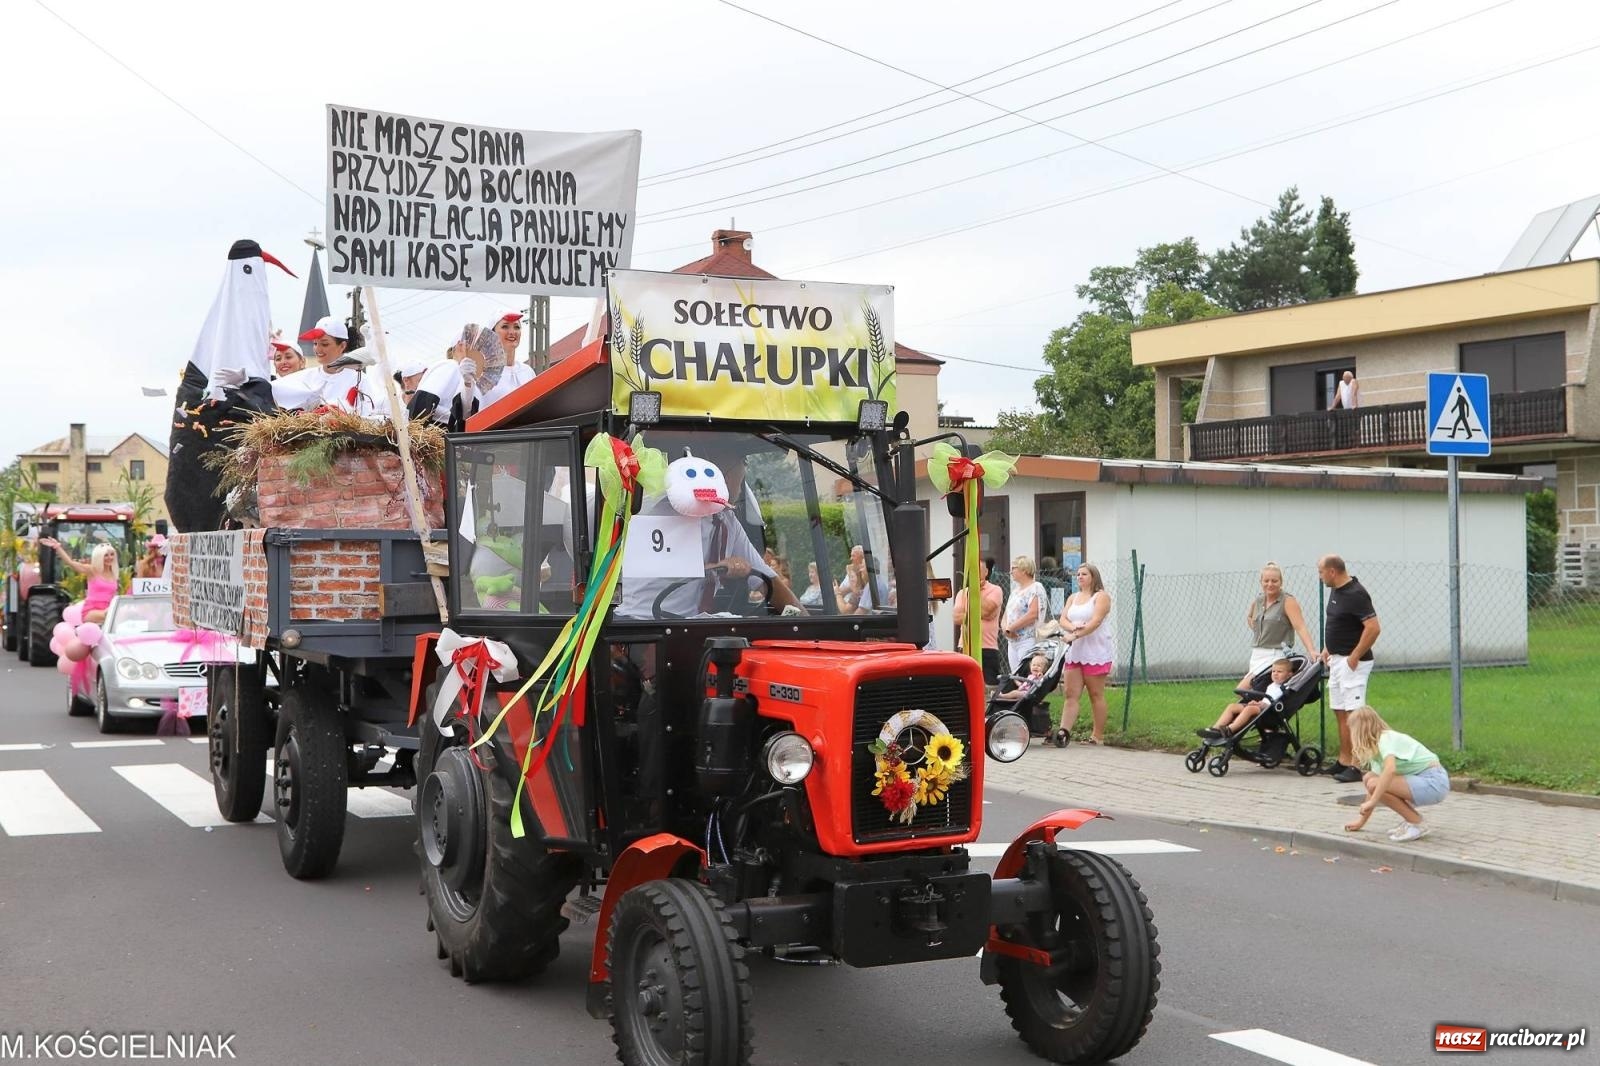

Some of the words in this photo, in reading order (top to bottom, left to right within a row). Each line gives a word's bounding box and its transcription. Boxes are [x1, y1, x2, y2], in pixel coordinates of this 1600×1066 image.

[331, 108, 368, 151] NIE
[375, 114, 445, 161] MASZ
[450, 126, 525, 166] SIANA
[332, 151, 437, 199] PRZYJDŹ
[445, 166, 472, 201] DO
[480, 169, 577, 206] BOCIANA
[333, 194, 382, 233] NAD
[388, 199, 503, 247] INFLACJĄ
[510, 209, 627, 249] PANUJEMY
[331, 235, 395, 278] SAMI
[407, 241, 474, 288] KASĘ
[674, 299, 833, 332] SOŁECTWO
[640, 338, 869, 388] CHAŁUPKI
[651, 528, 671, 553] 9.
[769, 684, 800, 701] C-330
